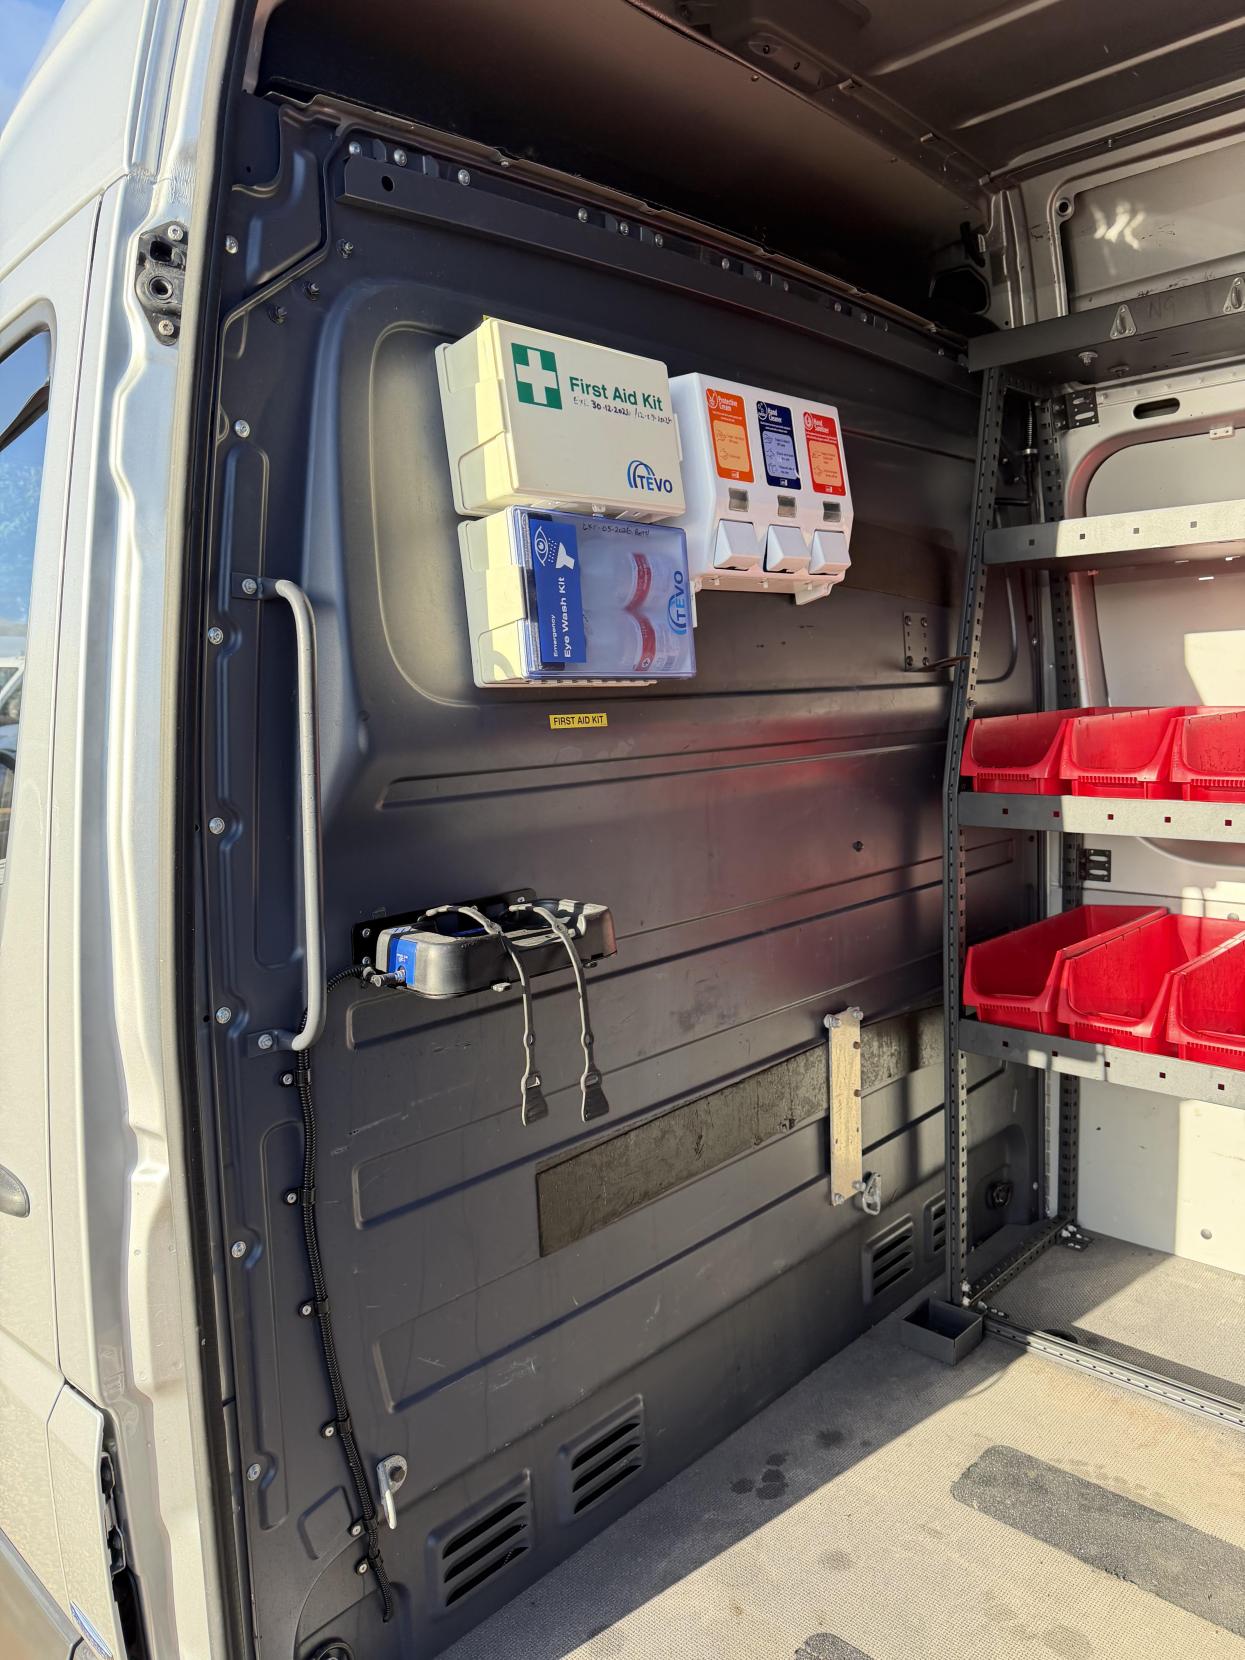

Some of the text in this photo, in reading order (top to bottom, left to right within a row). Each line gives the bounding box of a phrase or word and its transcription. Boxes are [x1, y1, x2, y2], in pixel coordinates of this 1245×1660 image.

[569, 376, 664, 411] First Aid Kit
[636, 475, 673, 493] TEVO
[673, 570, 687, 621] TEVO
[551, 614, 559, 657] Emergency
[558, 576, 572, 658] Eye Wash Kit
[553, 715, 604, 726] FIRST AID KIT
